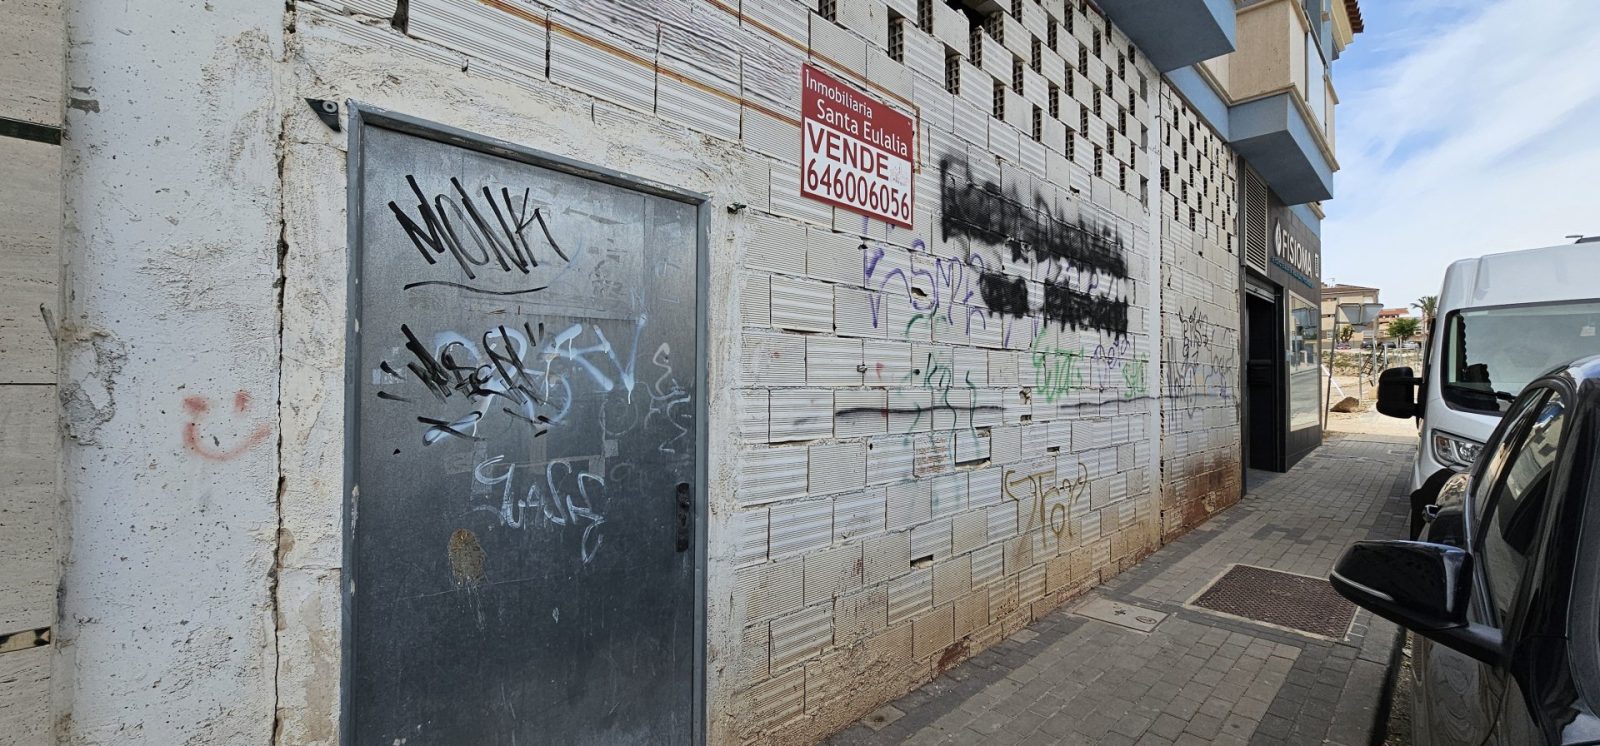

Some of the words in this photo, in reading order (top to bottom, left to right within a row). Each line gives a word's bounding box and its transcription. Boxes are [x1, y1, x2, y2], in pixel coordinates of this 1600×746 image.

[805, 69, 873, 119] Inmobiliaria
[807, 122, 889, 181] VENDE
[816, 99, 859, 136] Santa
[863, 120, 908, 157] Eulalia
[807, 158, 911, 221] 646006056
[1282, 229, 1313, 279] FISIOMA
